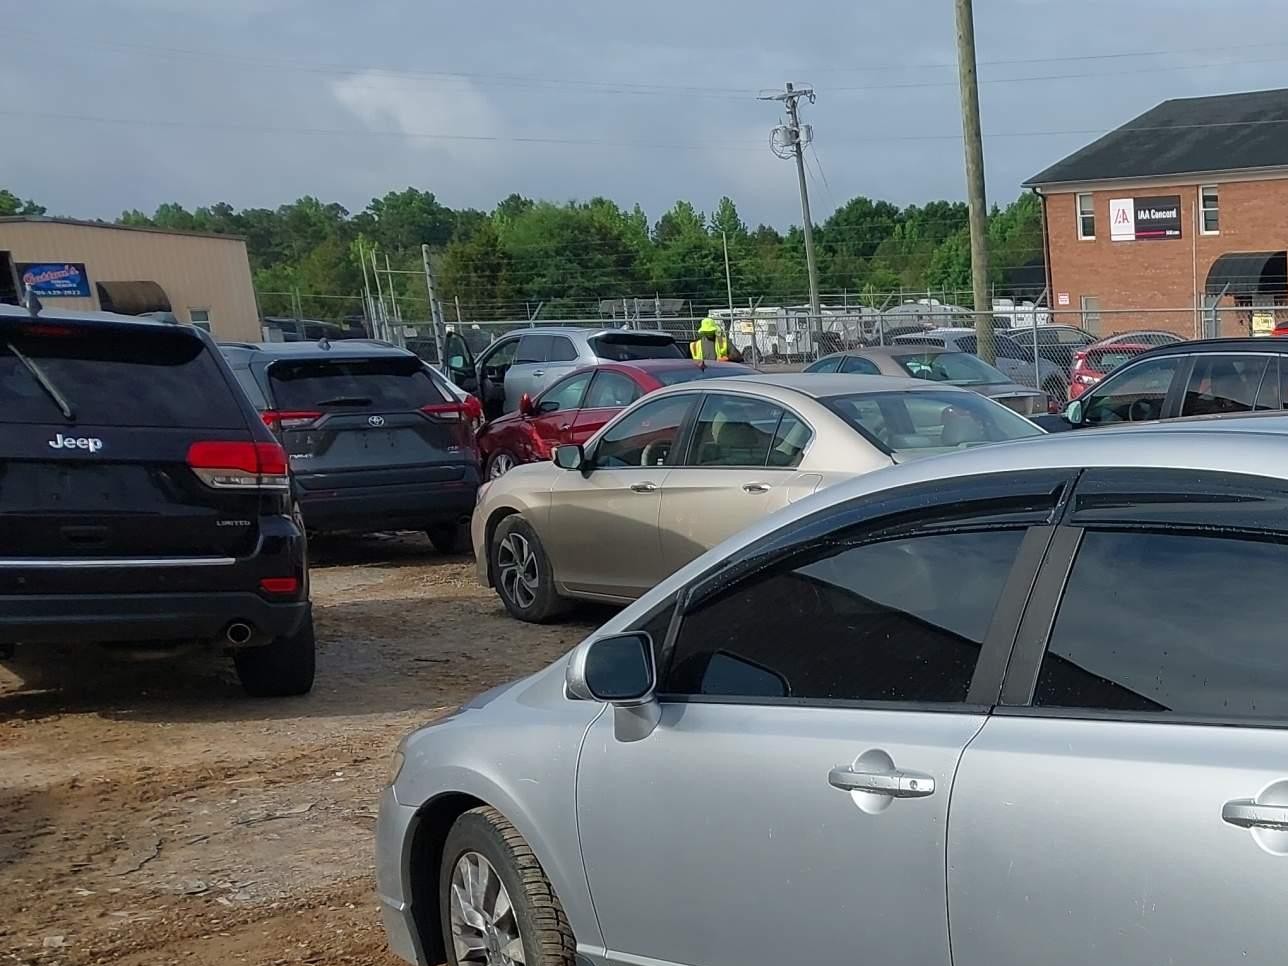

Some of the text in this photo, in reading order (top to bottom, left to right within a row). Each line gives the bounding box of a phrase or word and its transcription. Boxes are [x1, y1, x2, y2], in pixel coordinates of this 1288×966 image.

[1137, 207, 1177, 220] IAA Concord
[48, 433, 103, 453] Jeep
